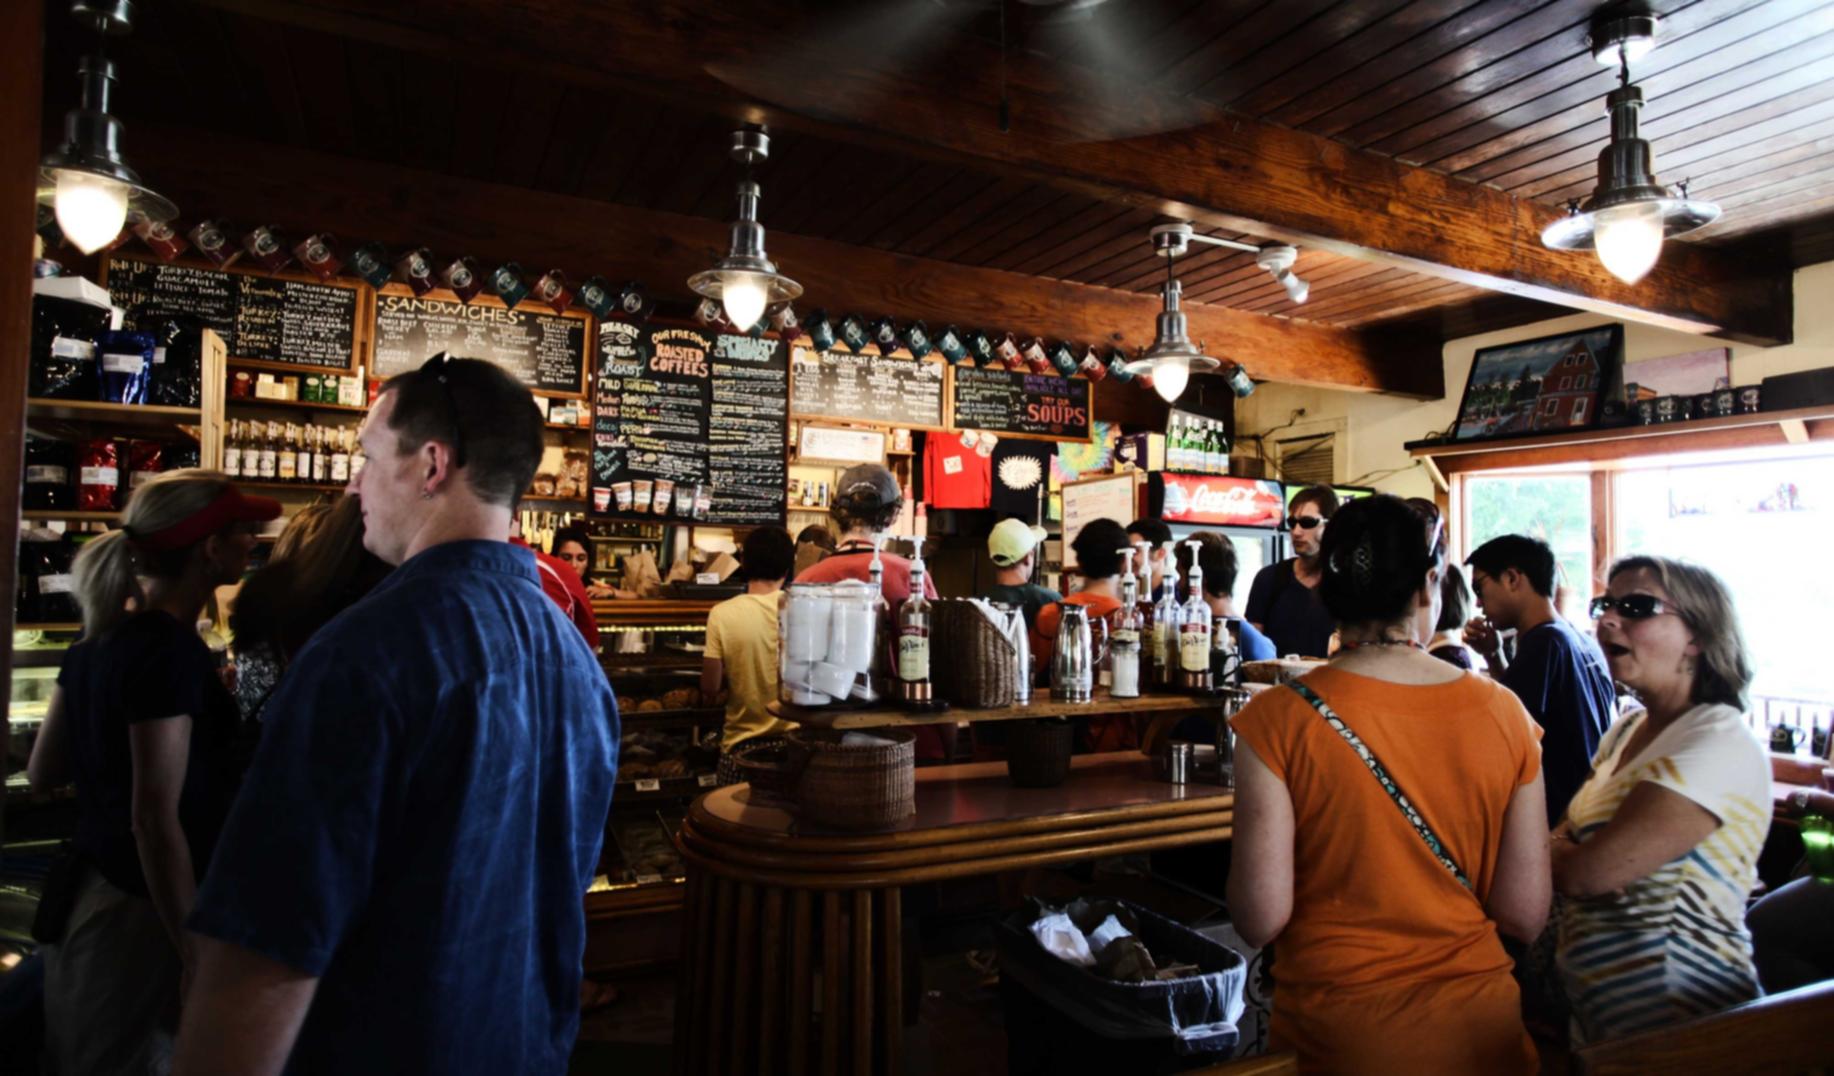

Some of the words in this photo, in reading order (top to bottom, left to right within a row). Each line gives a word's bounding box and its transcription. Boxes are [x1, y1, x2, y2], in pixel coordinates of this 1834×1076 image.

[385, 296, 518, 325] SANDWICHES
[656, 343, 704, 362] ROASTED
[650, 357, 709, 378] COFFEES
[598, 378, 621, 390] MILD
[597, 405, 620, 417] DARK
[1027, 403, 1086, 427] SOUPS
